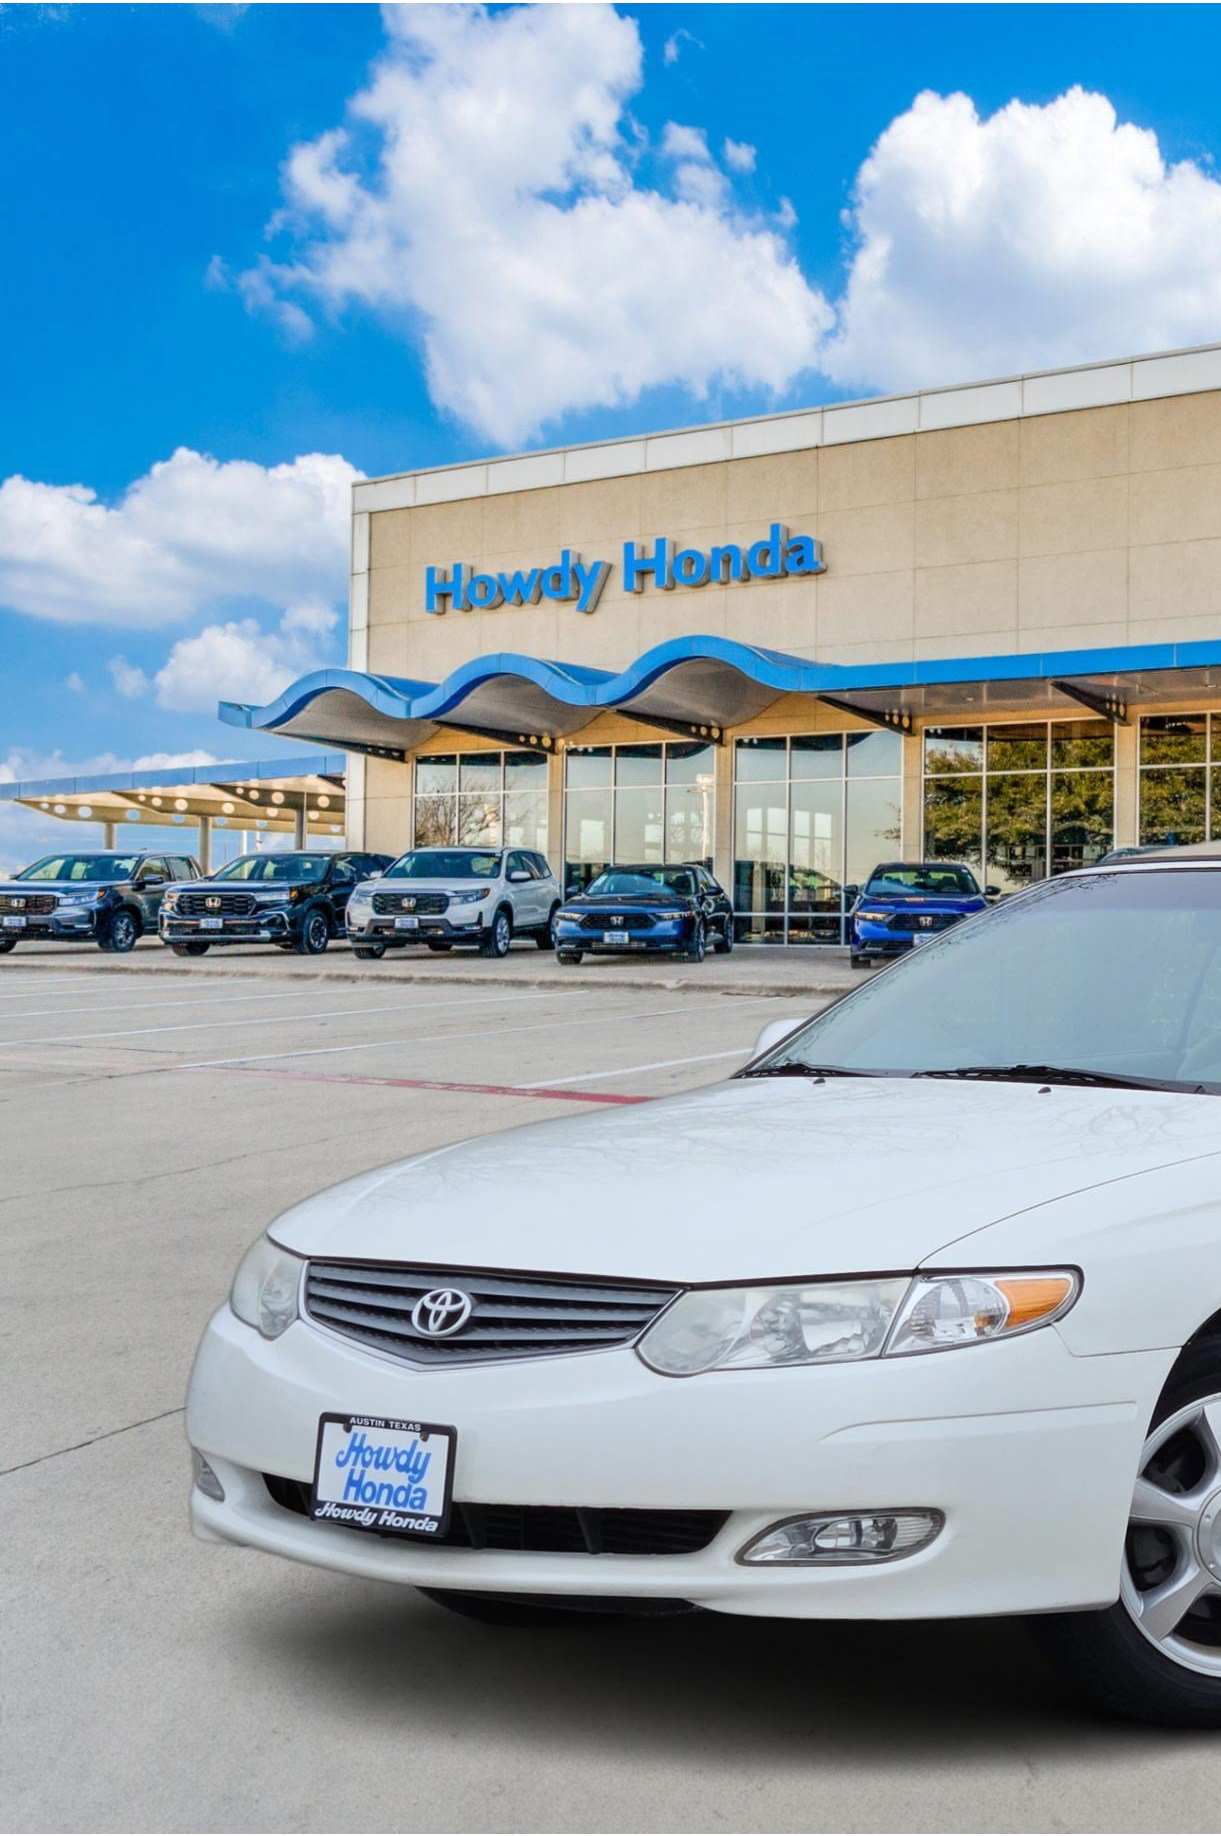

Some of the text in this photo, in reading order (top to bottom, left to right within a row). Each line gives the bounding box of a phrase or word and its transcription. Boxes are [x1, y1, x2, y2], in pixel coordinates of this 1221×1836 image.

[425, 523, 827, 614] Howdy Honda
[350, 1417, 422, 1431] AUSTIN TEXAS
[335, 1432, 432, 1484] Howdy
[343, 1469, 428, 1511] Honda
[315, 1502, 439, 1532] Howdy Honda
